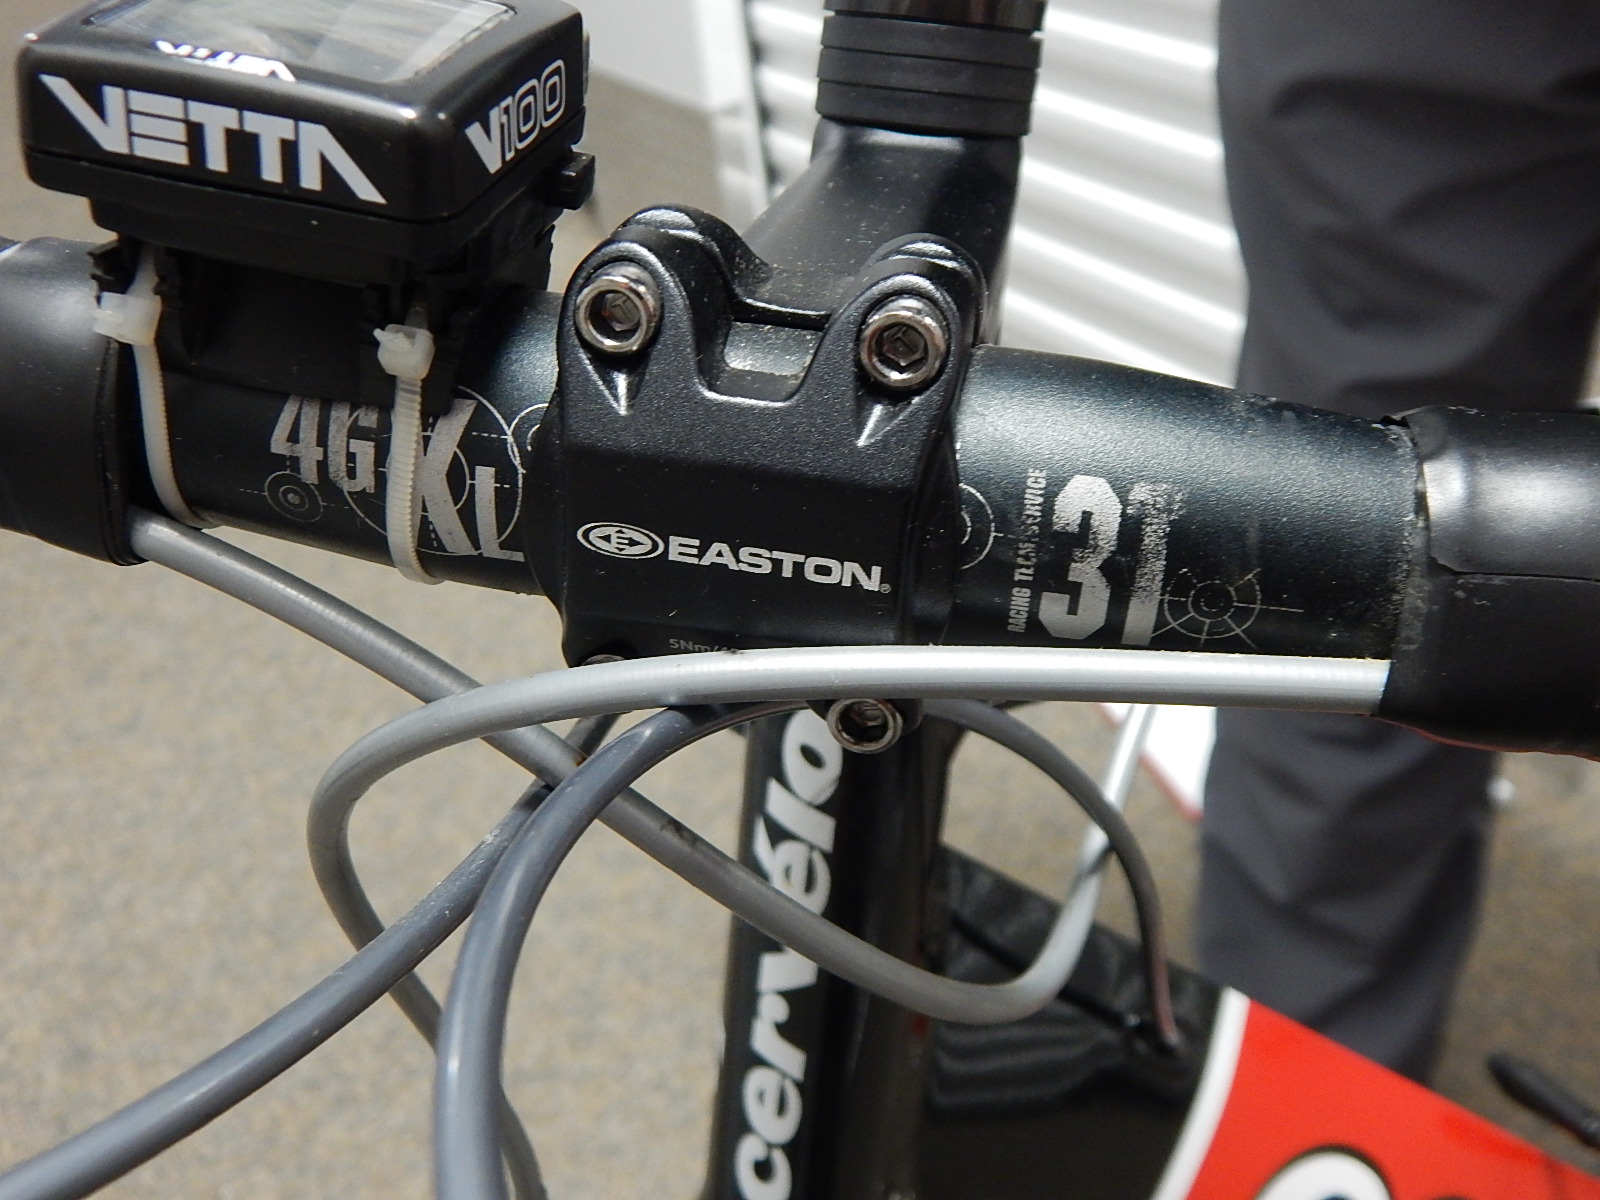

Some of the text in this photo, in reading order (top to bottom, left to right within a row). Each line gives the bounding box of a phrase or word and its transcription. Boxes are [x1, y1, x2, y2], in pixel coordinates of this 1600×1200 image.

[38, 73, 388, 205] VETTA
[464, 58, 567, 175] V100
[668, 535, 883, 592] EASTON
[1007, 586, 1032, 633] RACING
